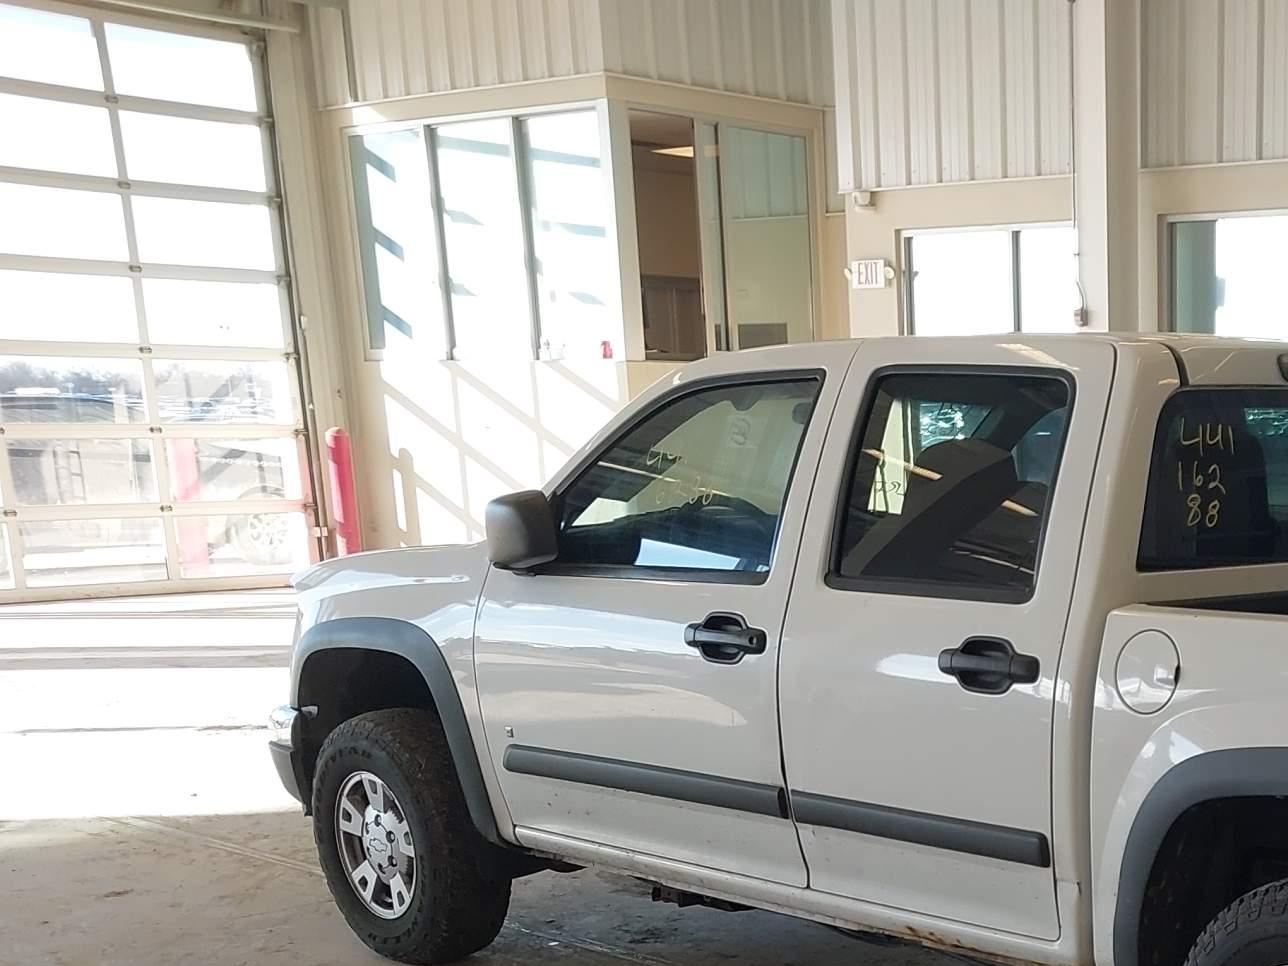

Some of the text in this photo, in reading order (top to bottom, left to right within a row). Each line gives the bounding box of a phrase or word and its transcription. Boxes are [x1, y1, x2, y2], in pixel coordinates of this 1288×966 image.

[857, 261, 878, 285] EXIT
[1180, 417, 1235, 457] 441
[1178, 460, 1226, 495] 162
[1186, 493, 1220, 528] 88
